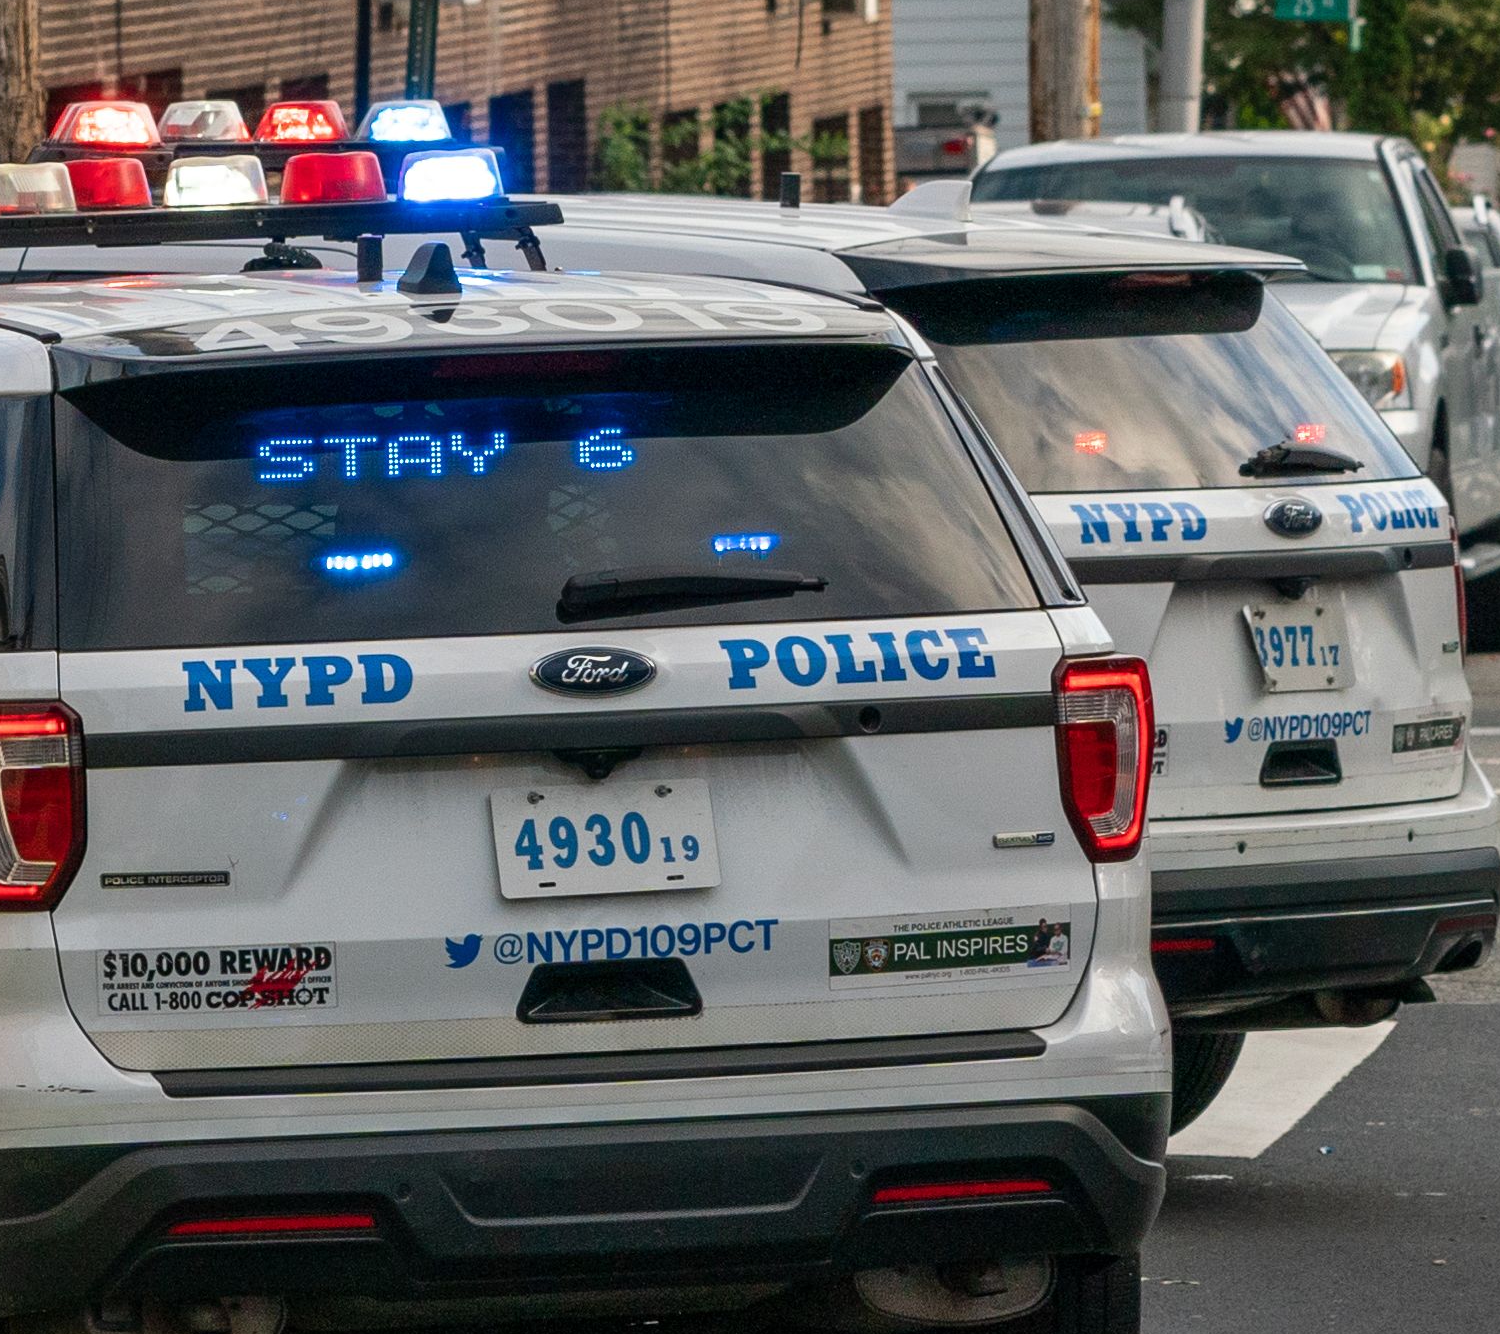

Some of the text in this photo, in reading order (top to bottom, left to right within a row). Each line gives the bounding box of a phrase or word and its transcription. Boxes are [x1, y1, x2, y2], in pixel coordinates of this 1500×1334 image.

[194, 299, 828, 353] 493019
[260, 428, 633, 479] STAY 6
[1071, 501, 1208, 544] NYPD
[1336, 489, 1440, 534] POLICE
[182, 627, 998, 712] NYPD Ford POLICE
[1247, 710, 1373, 743] @NYPD109PCT
[514, 811, 700, 871] 4930 19
[104, 874, 226, 886] POLICE INTERCEPTOR
[493, 918, 780, 965] @NYPD109PCT
[893, 917, 1014, 933] THE POLICE ATHLETIC LEAGUE
[103, 946, 332, 982] $10,000 REWARD
[893, 934, 1028, 962] PAL INSPIRES
[107, 992, 149, 1011] CALL
